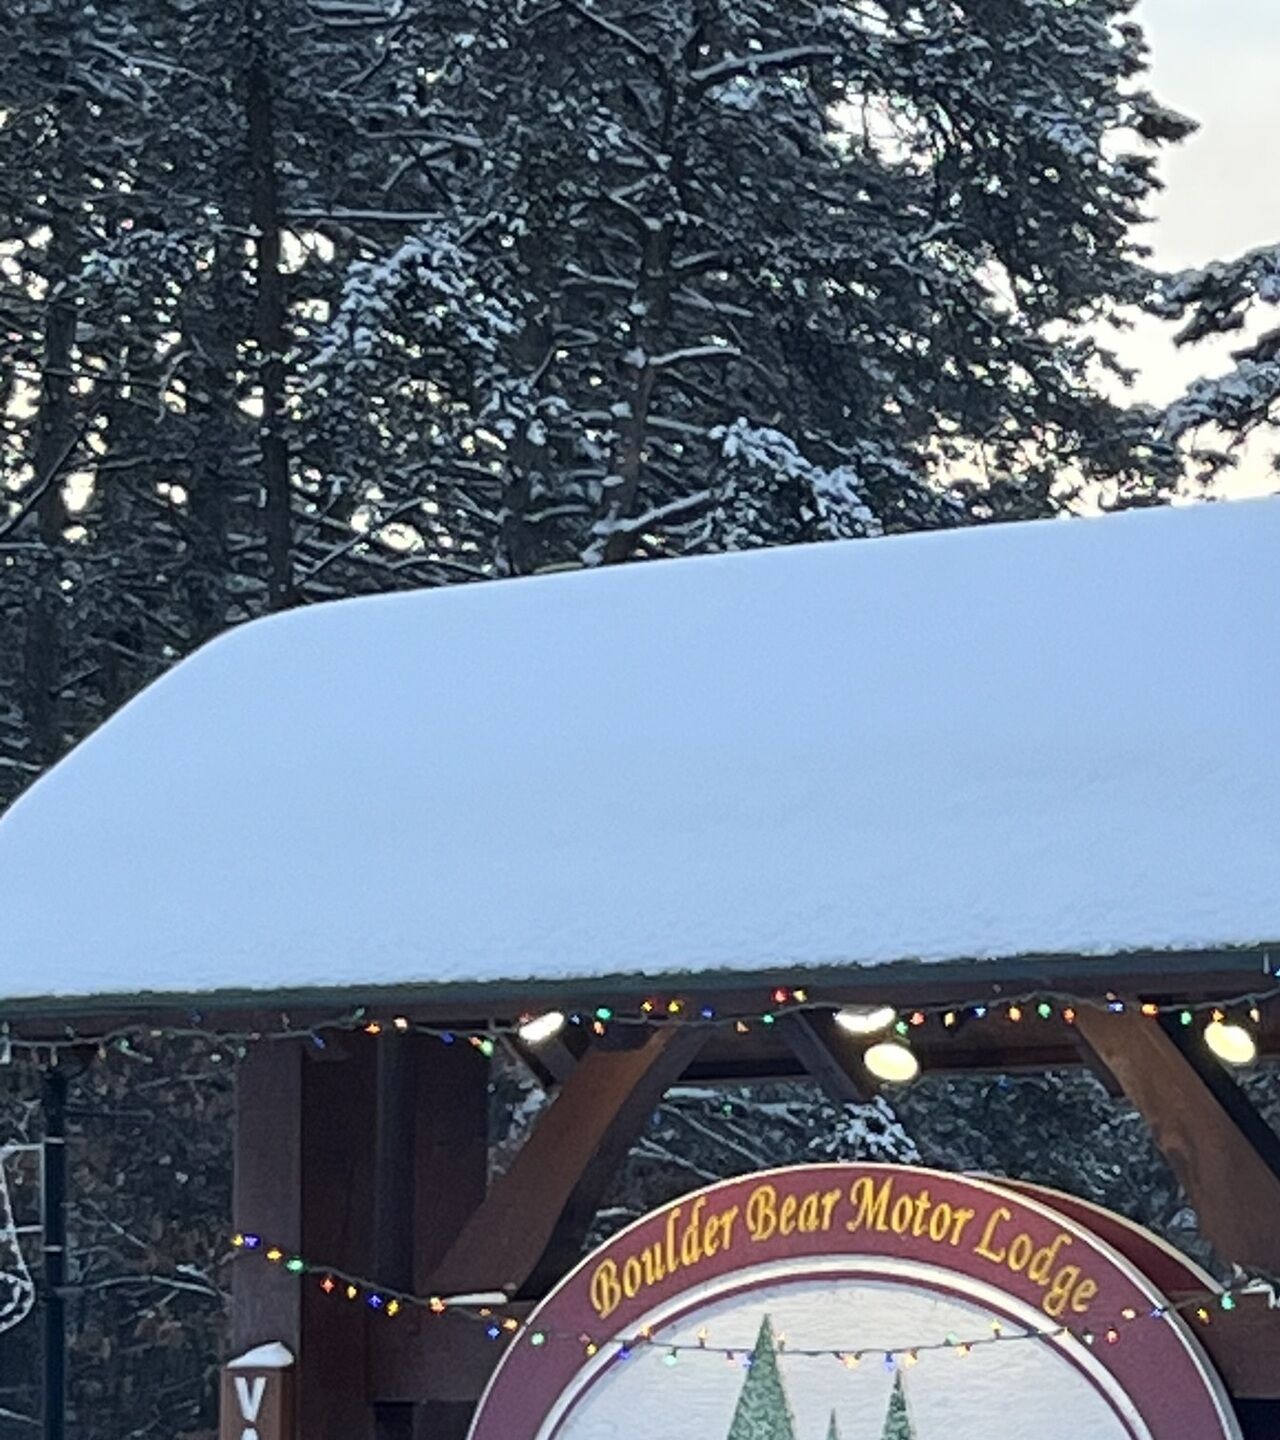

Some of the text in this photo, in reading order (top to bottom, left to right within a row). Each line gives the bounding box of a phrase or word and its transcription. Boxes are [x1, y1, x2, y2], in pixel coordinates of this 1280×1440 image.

[589, 1176, 1100, 1320] Boulder Bear Motor Lodge
